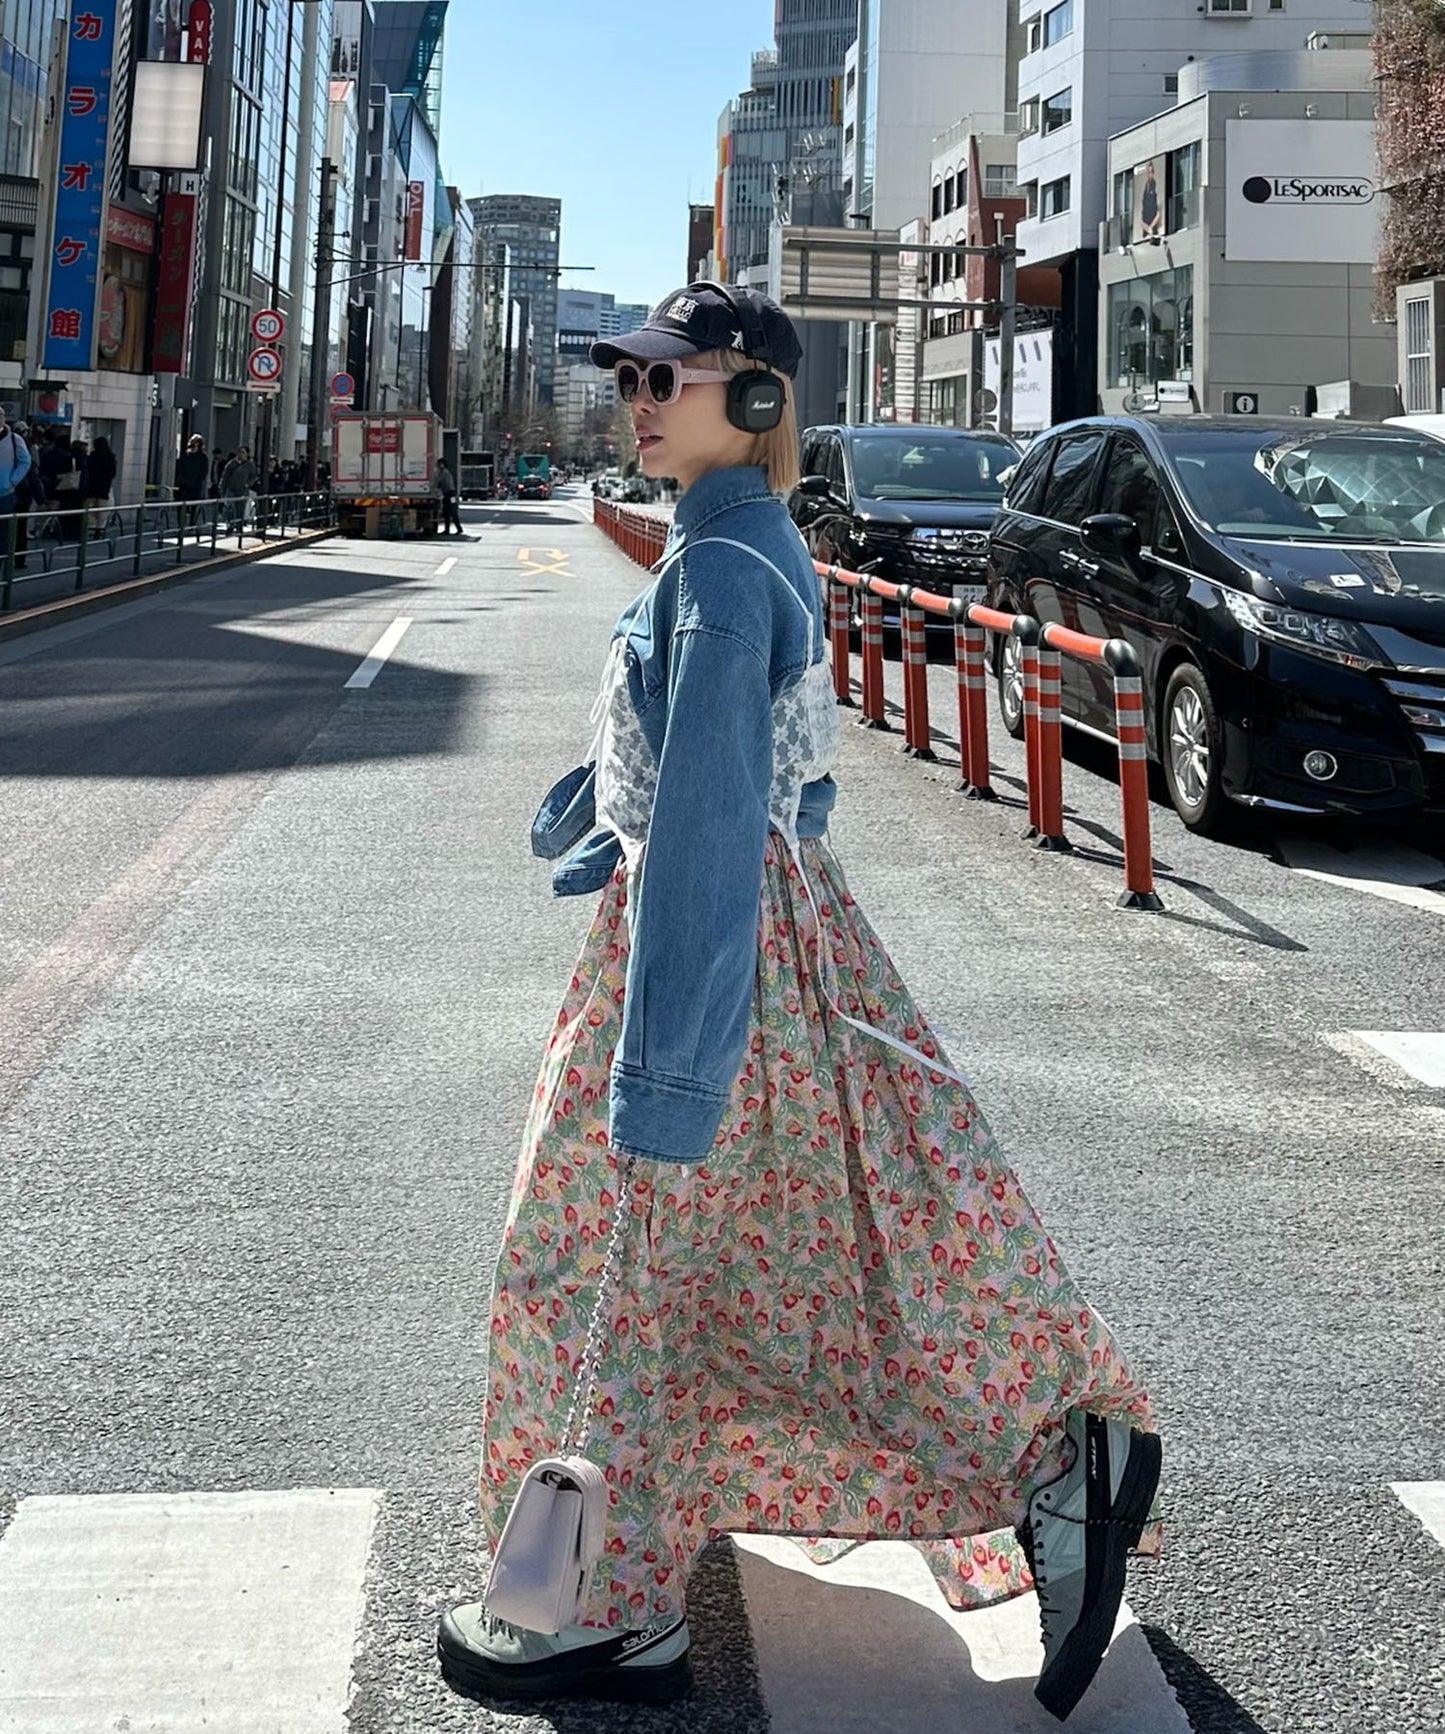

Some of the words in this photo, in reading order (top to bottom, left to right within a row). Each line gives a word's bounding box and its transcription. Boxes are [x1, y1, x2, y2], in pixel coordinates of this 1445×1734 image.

[49, 11, 104, 340] カラオケ館
[258, 318, 277, 334] 50
